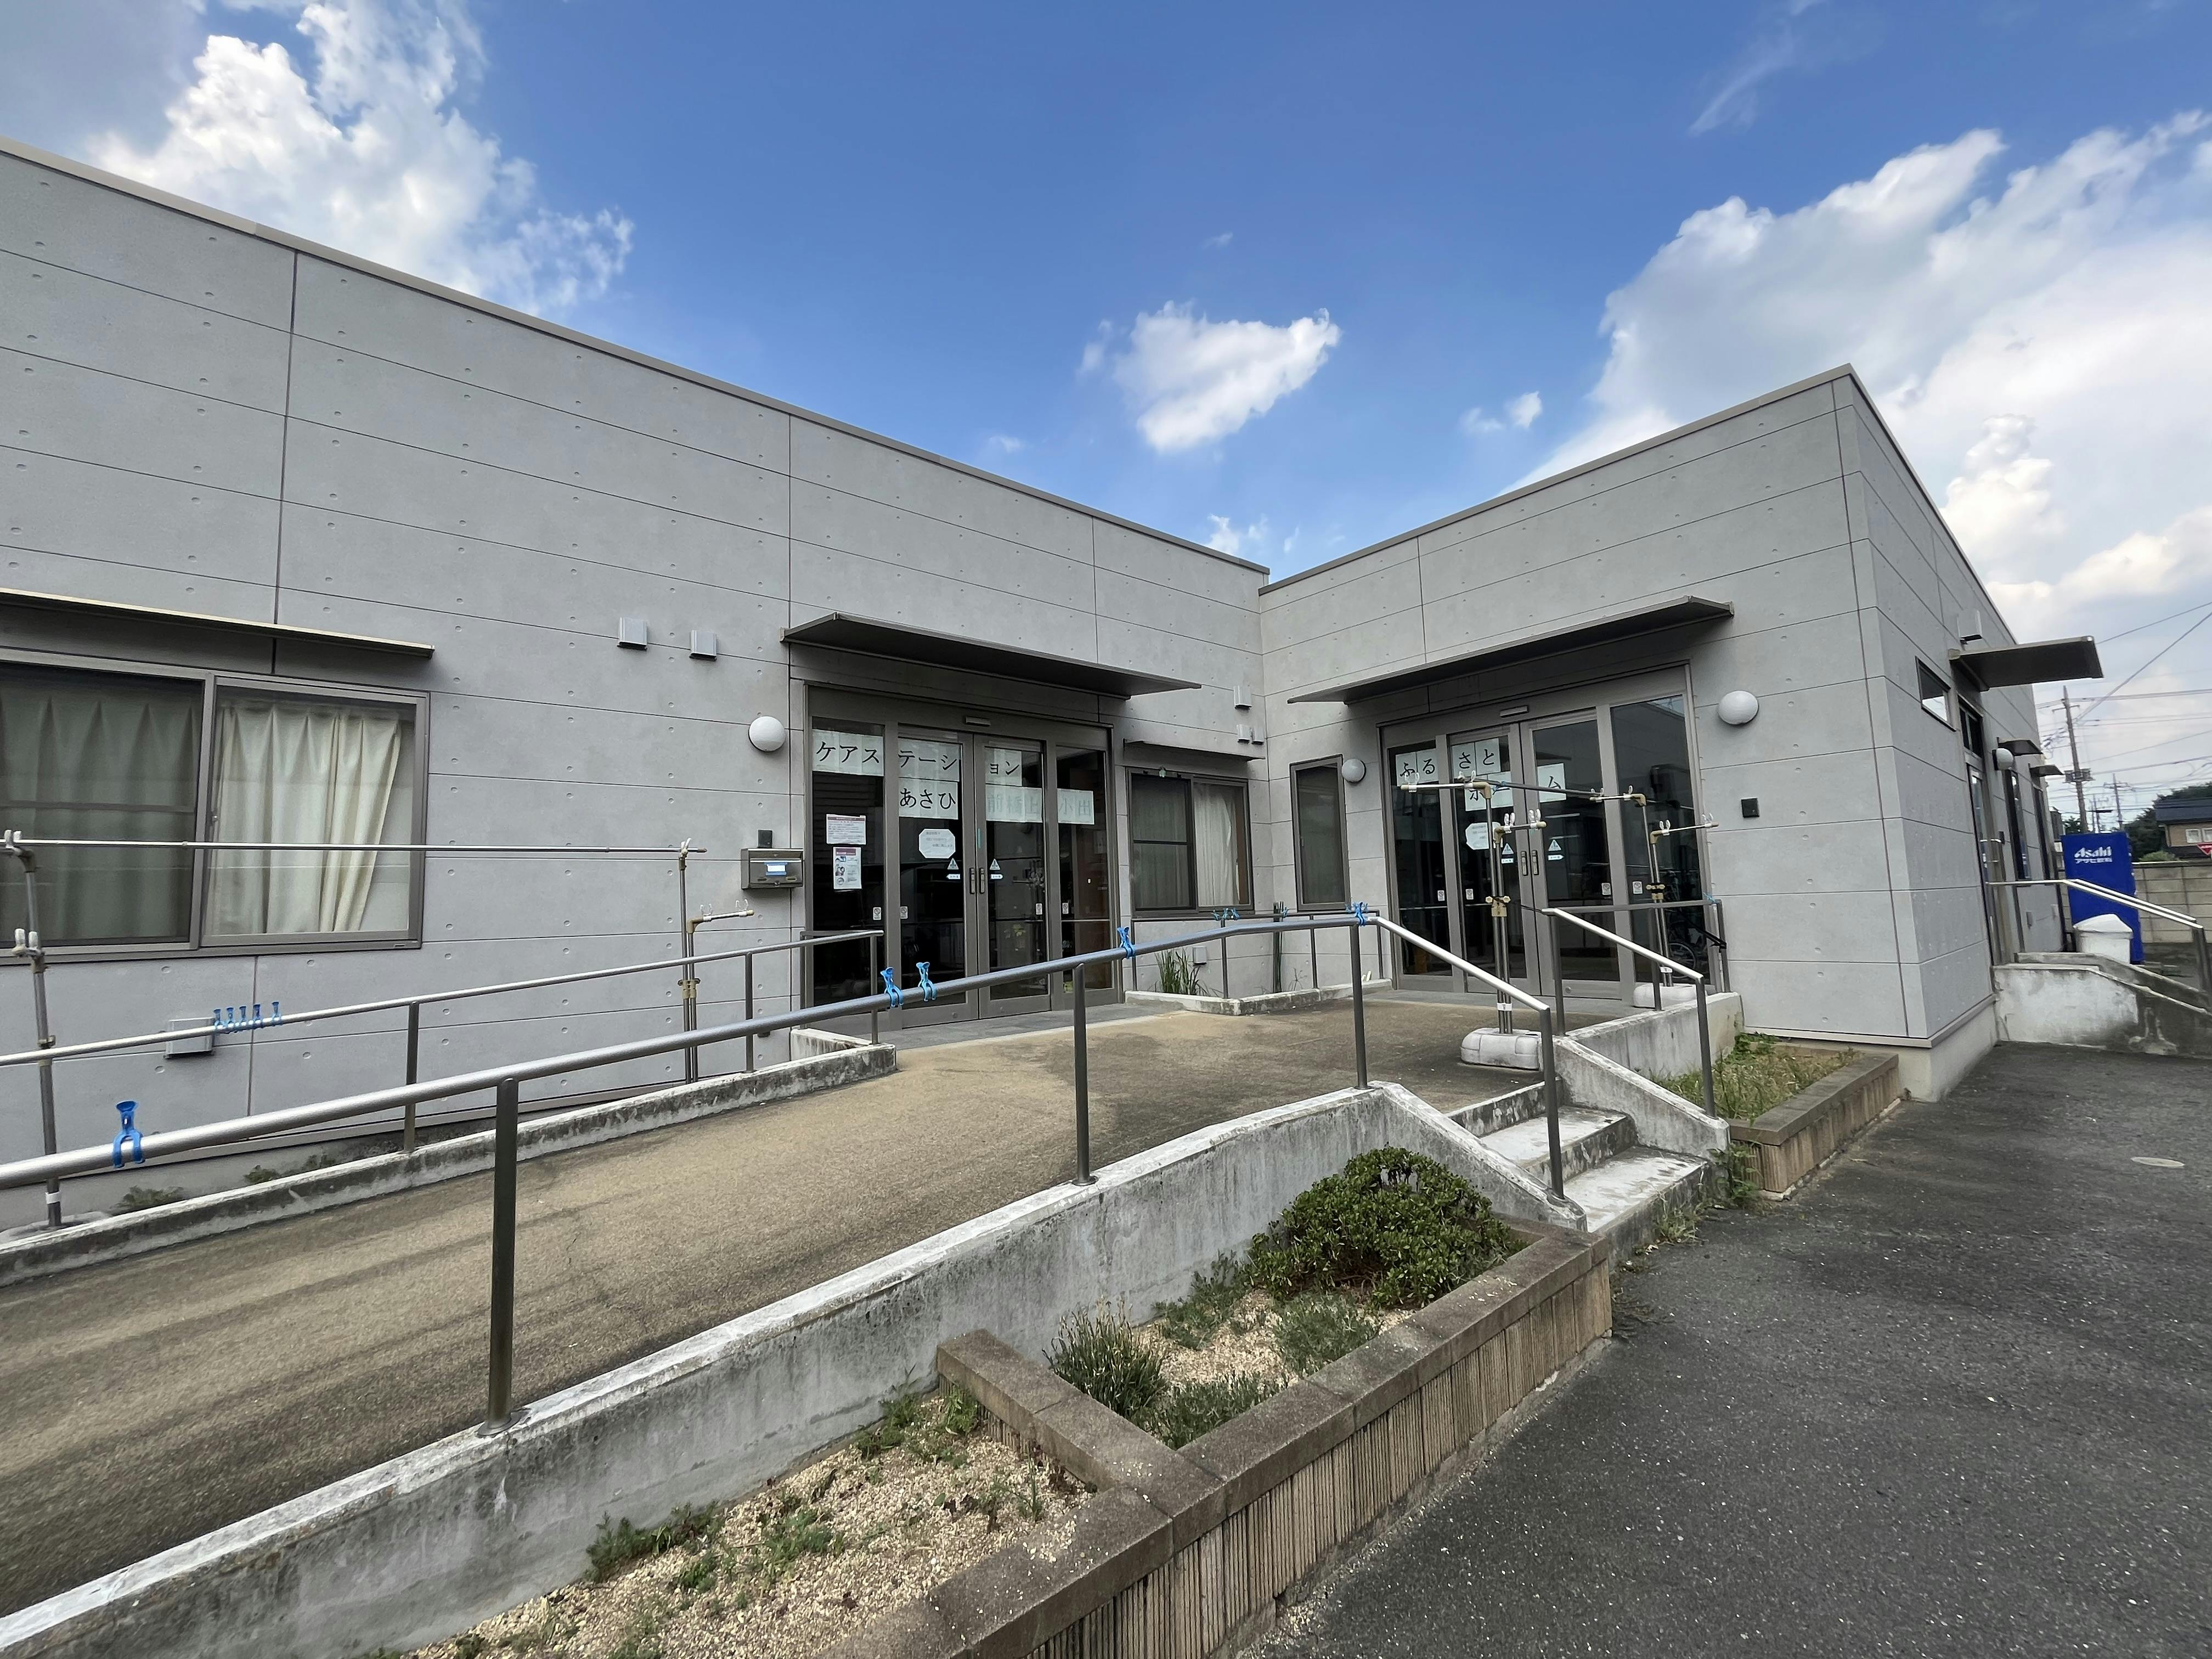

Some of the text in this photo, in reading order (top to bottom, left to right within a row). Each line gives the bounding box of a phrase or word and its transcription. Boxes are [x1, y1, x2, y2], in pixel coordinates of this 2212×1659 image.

[1400, 749, 1494, 777] ふるさと
[900, 788, 956, 810] あさひ
[2074, 846, 2112, 858] Asahi
